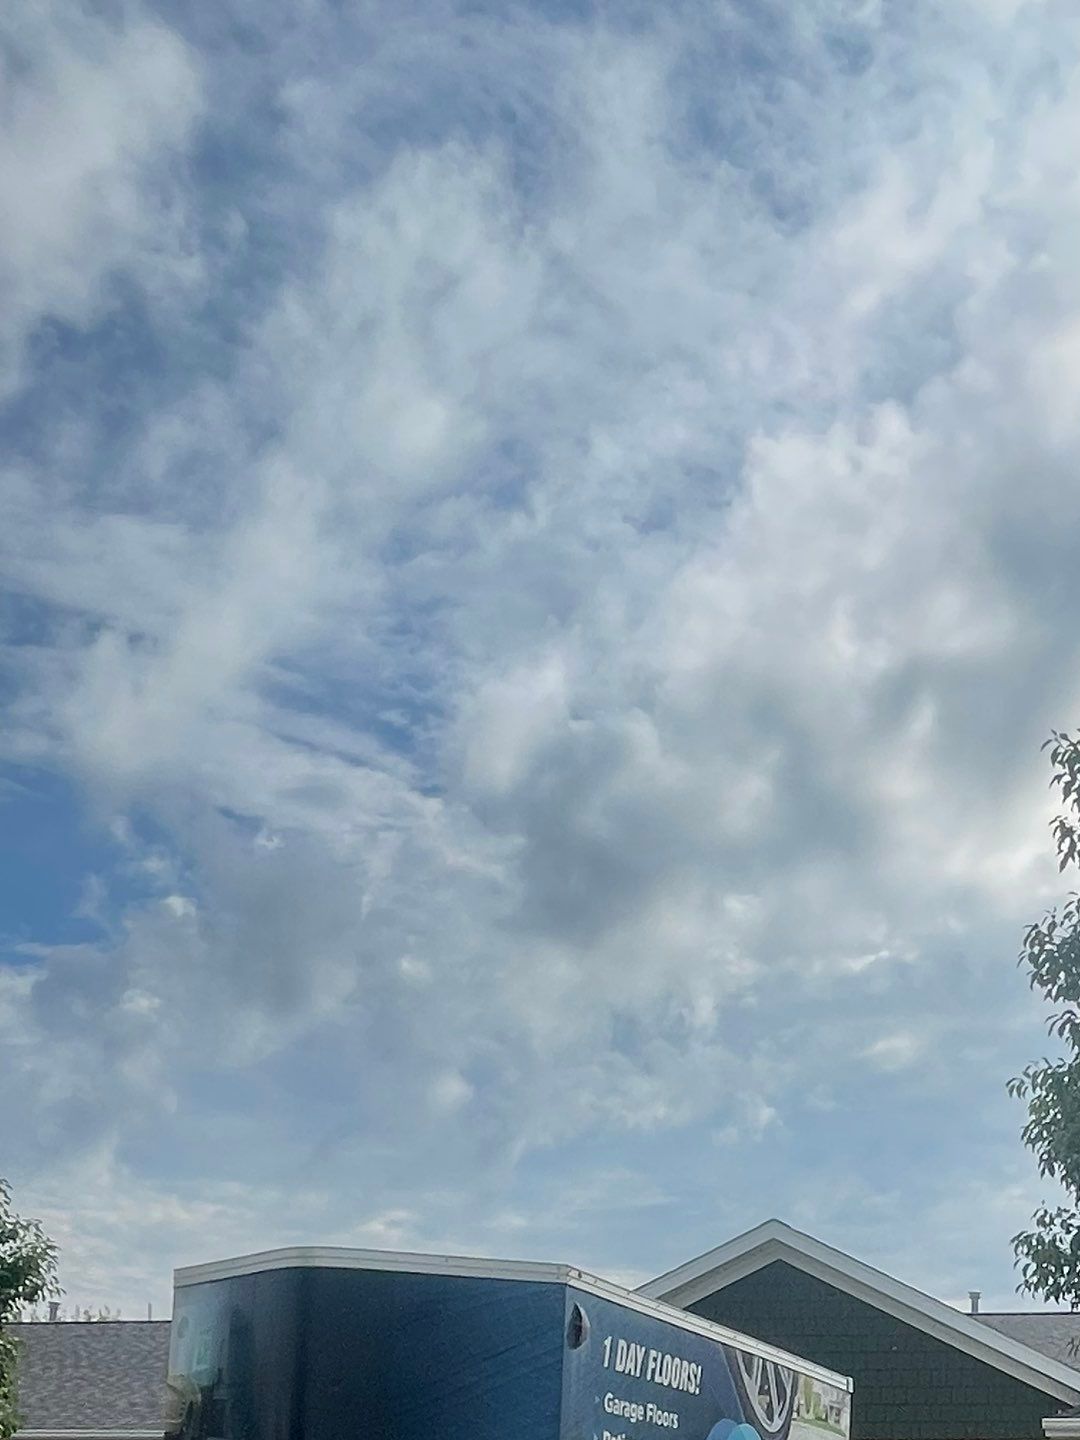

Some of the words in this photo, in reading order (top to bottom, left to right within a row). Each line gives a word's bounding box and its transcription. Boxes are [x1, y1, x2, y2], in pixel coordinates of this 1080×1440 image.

[603, 1336, 612, 1369] 1
[615, 1341, 643, 1378] DAY
[647, 1347, 703, 1395] FLOORS!
[603, 1393, 645, 1425] Garage
[646, 1401, 679, 1430] Floors
